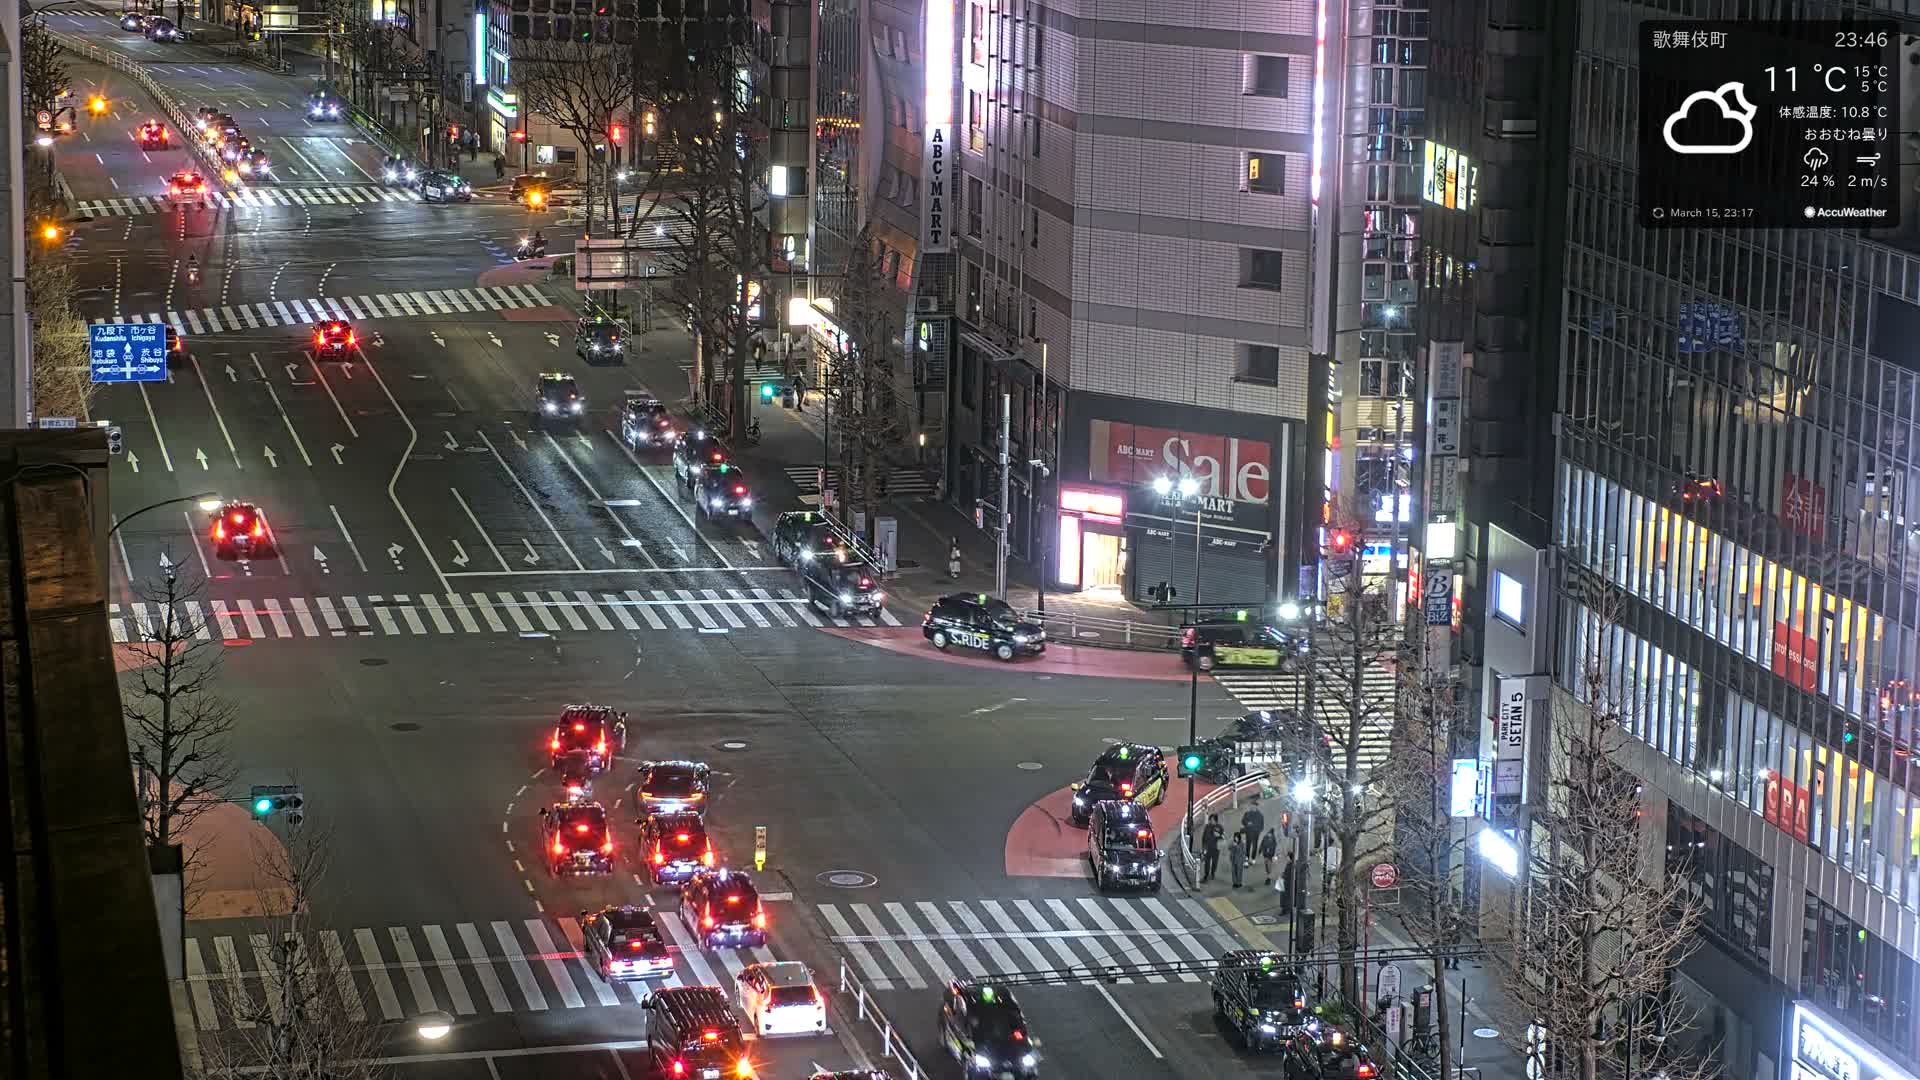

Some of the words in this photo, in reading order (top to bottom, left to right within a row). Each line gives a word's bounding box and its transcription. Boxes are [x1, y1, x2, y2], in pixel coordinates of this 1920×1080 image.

[97, 326, 125, 336] 九段下
[140, 356, 164, 364] Shibuya
[141, 347, 163, 357] 渋谷
[1162, 436, 1269, 504] Sale
[951, 633, 990, 650] S.RIDE
[1511, 692, 1524, 702] 5
[1502, 703, 1510, 720] CITY
[1501, 722, 1509, 740] PARK
[1509, 706, 1523, 747] ISETAN
[1766, 780, 1807, 831] CPA
